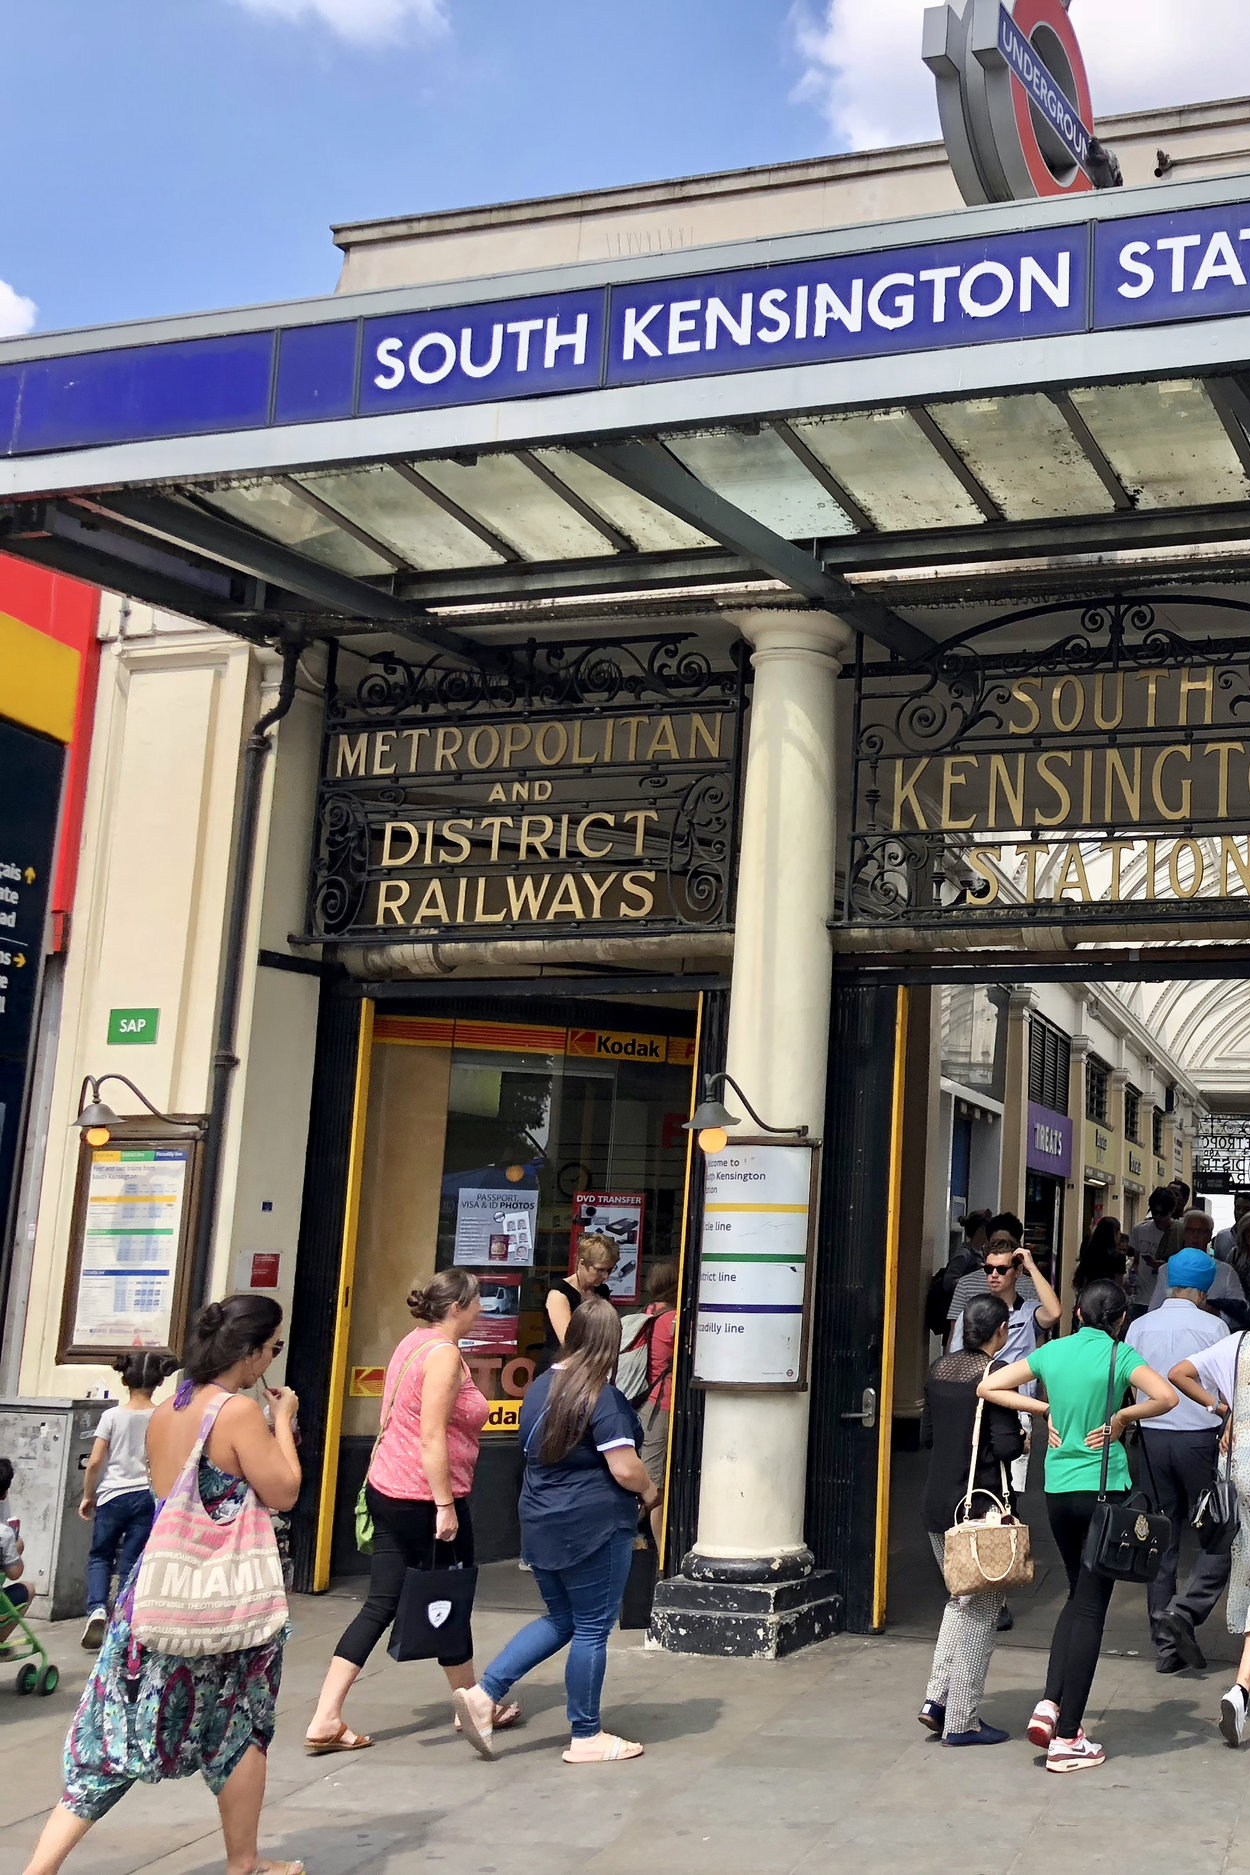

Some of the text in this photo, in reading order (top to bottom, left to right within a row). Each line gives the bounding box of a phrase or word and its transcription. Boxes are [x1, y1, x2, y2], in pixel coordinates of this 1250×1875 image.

[1002, 20, 1090, 161] UNDERGROUN
[373, 313, 589, 391] SOUTH
[622, 251, 1071, 361] KENSINGTON
[1008, 665, 1216, 736] SOUTH
[335, 712, 724, 778] METROPOLITAN
[487, 780, 554, 803] AND
[380, 808, 660, 868] DISTRICT
[375, 870, 657, 926] RAILWAYS
[119, 1018, 146, 1033] SAP
[597, 1035, 661, 1058] Kodak
[730, 1158, 740, 1168] to
[716, 1171, 767, 1183] Kensington
[461, 1201, 479, 1209] VISA
[499, 1202, 535, 1210] PHOTOS
[476, 1193, 519, 1202] PASSPORT,
[576, 1194, 642, 1204] DVD TRANSFER
[715, 1221, 732, 1232] line
[718, 1272, 737, 1282] line
[724, 1323, 745, 1333] line
[160, 1557, 265, 1600] MIAMI
